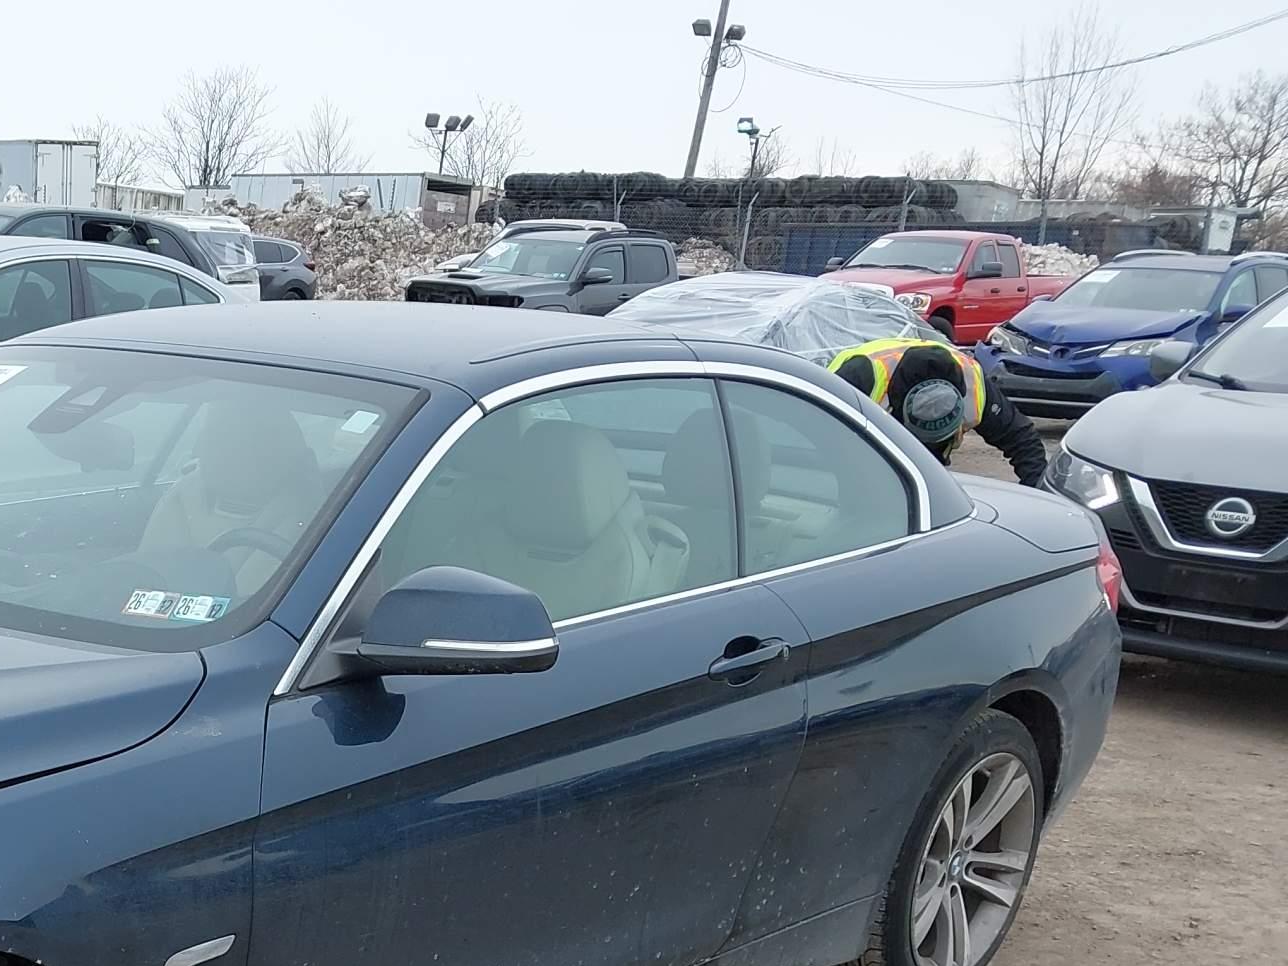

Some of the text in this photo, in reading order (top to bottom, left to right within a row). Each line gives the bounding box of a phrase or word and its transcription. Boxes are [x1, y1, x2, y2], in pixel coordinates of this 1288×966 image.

[1212, 511, 1250, 522] NISSAN
[127, 593, 146, 611] 26
[176, 597, 194, 616] 26
